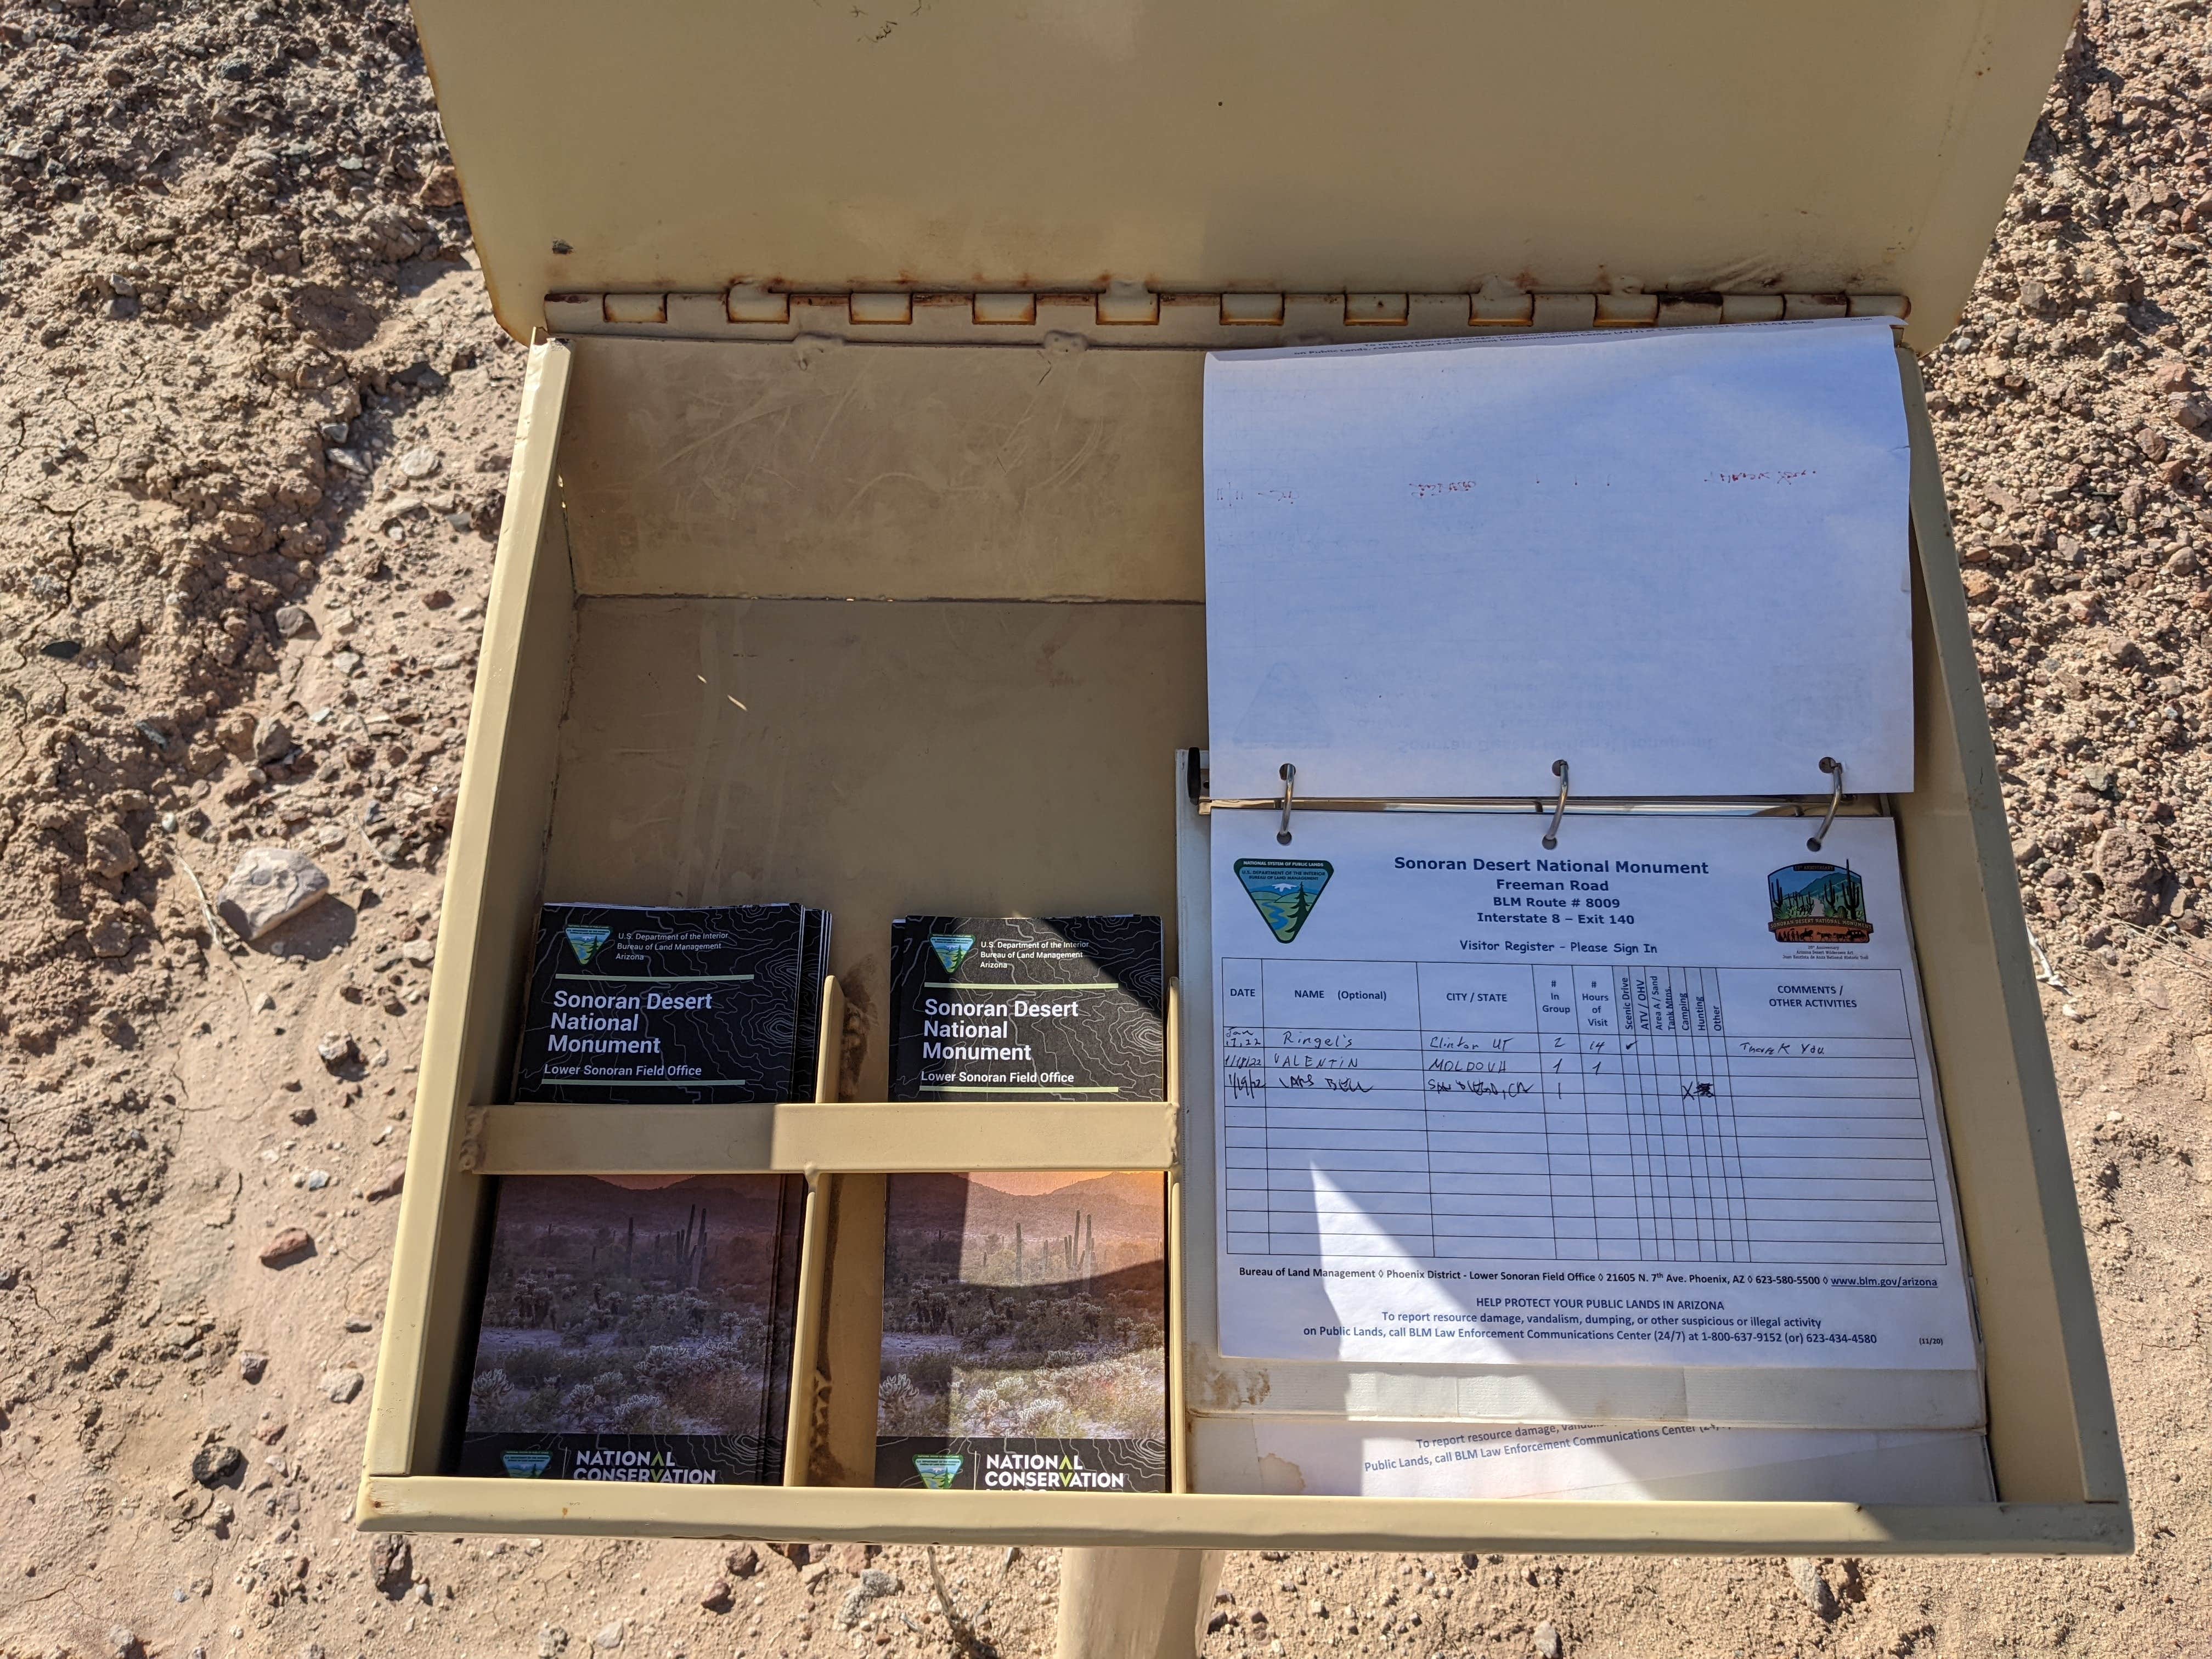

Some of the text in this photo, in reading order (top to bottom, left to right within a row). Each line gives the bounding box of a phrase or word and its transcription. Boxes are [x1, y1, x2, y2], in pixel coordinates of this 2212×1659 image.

[1394, 856, 1709, 874] Sonoran Desert National Monument
[1496, 878, 1609, 891] Freeman Road
[1493, 896, 1620, 909] BLM Route # 8009
[1476, 912, 1634, 924] Interstate 8 Exit 140
[997, 941, 1040, 950] Department
[1459, 939, 1657, 956] Visitor Register Please Sign In
[1036, 951, 1084, 961] Management
[1229, 988, 1256, 997] DATE
[1650, 975, 1660, 996] Sand
[1777, 985, 1837, 994] COMMENTS
[553, 990, 713, 1010] Sonoran Desert
[1294, 989, 1386, 1001] NAME (Optional)
[1446, 992, 1508, 1002] CITY STATE
[1550, 992, 1560, 1000] In
[1581, 992, 1609, 1001] Hours
[1621, 977, 1633, 1030] Scenic Drive
[1768, 998, 1857, 1008] OTHER ACTIVITIES
[924, 998, 1079, 1018] Sonoran Desert
[1542, 1004, 1571, 1014] Group
[1591, 1005, 1601, 1014] of
[1636, 979, 1650, 1030] ATV OHV
[1664, 986, 1676, 1031] Tank Mtns.
[1679, 992, 1690, 1031] Camping
[550, 1012, 639, 1031] National
[1587, 1018, 1609, 1026] Visit
[1654, 1011, 1663, 1031] Area
[1695, 996, 1706, 1031] Hunting
[1713, 1005, 1722, 1031] Other
[923, 1020, 1008, 1039] National
[548, 1034, 661, 1054] Monument
[922, 1041, 1032, 1061] Monument
[1554, 1037, 1565, 1048] 2
[544, 1063, 702, 1076] Lower Sonoran Field Office
[921, 1070, 1075, 1083] Lower Sonoran Field Office
[1239, 1266, 1273, 1276] Bureau
[1274, 1267, 1285, 1276] of
[1287, 1267, 1310, 1277] Land
[1312, 1268, 1376, 1279] Management
[1386, 1268, 1425, 1279] Phoenix
[1426, 1269, 1461, 1279] District
[1469, 1271, 1498, 1280] Lower
[1500, 1271, 1540, 1280] Sonoran
[1542, 1272, 1565, 1281] Field
[1566, 1272, 1595, 1282] Office
[1605, 1272, 1635, 1282] 21605
[1638, 1273, 1649, 1282] N.
[1666, 1273, 1686, 1283] Ave.
[1688, 1273, 1730, 1285] Phoenix,
[1732, 1274, 1745, 1284] AZ
[1754, 1274, 1820, 1285] 623-580-5500
[1830, 1276, 1938, 1288] www.blm.gov/arizona
[1476, 1297, 1725, 1310] HELP PROTECT YOUR PUBLIC LANDS IN ARIZONA
[1381, 1311, 1395, 1321] To
[1397, 1312, 1431, 1324] report
[1432, 1314, 1477, 1322] resource
[1479, 1312, 1524, 1325] damage,
[1526, 1313, 1582, 1325] vandalism,
[1584, 1313, 1634, 1327] dumping,
[1650, 1314, 1679, 1325] other
[1680, 1316, 1734, 1328] suspicious
[1750, 1316, 1781, 1329] illegal
[1783, 1317, 1821, 1329] activity
[1302, 1325, 1877, 1345] on Public Lands, call BLM Law Enforcement Communications Center (24/7) at 1-800-637-9152 (or) 623-434-4580
[1918, 1336, 1943, 1346] (11/20)
[575, 1450, 676, 1467] NATIONAL
[1364, 1459, 1397, 1473] Public
[1399, 1454, 1433, 1469] Lands,
[1434, 1451, 1453, 1464] call
[1454, 1448, 1479, 1461] BLM
[1480, 1446, 1502, 1458] Law
[1503, 1438, 1571, 1455] Enforcement
[1572, 1427, 1660, 1447] Communications
[986, 1454, 1084, 1470] NATIONAL
[573, 1467, 716, 1485] CONSERVATION
[984, 1471, 1124, 1488] CONSERVATION
